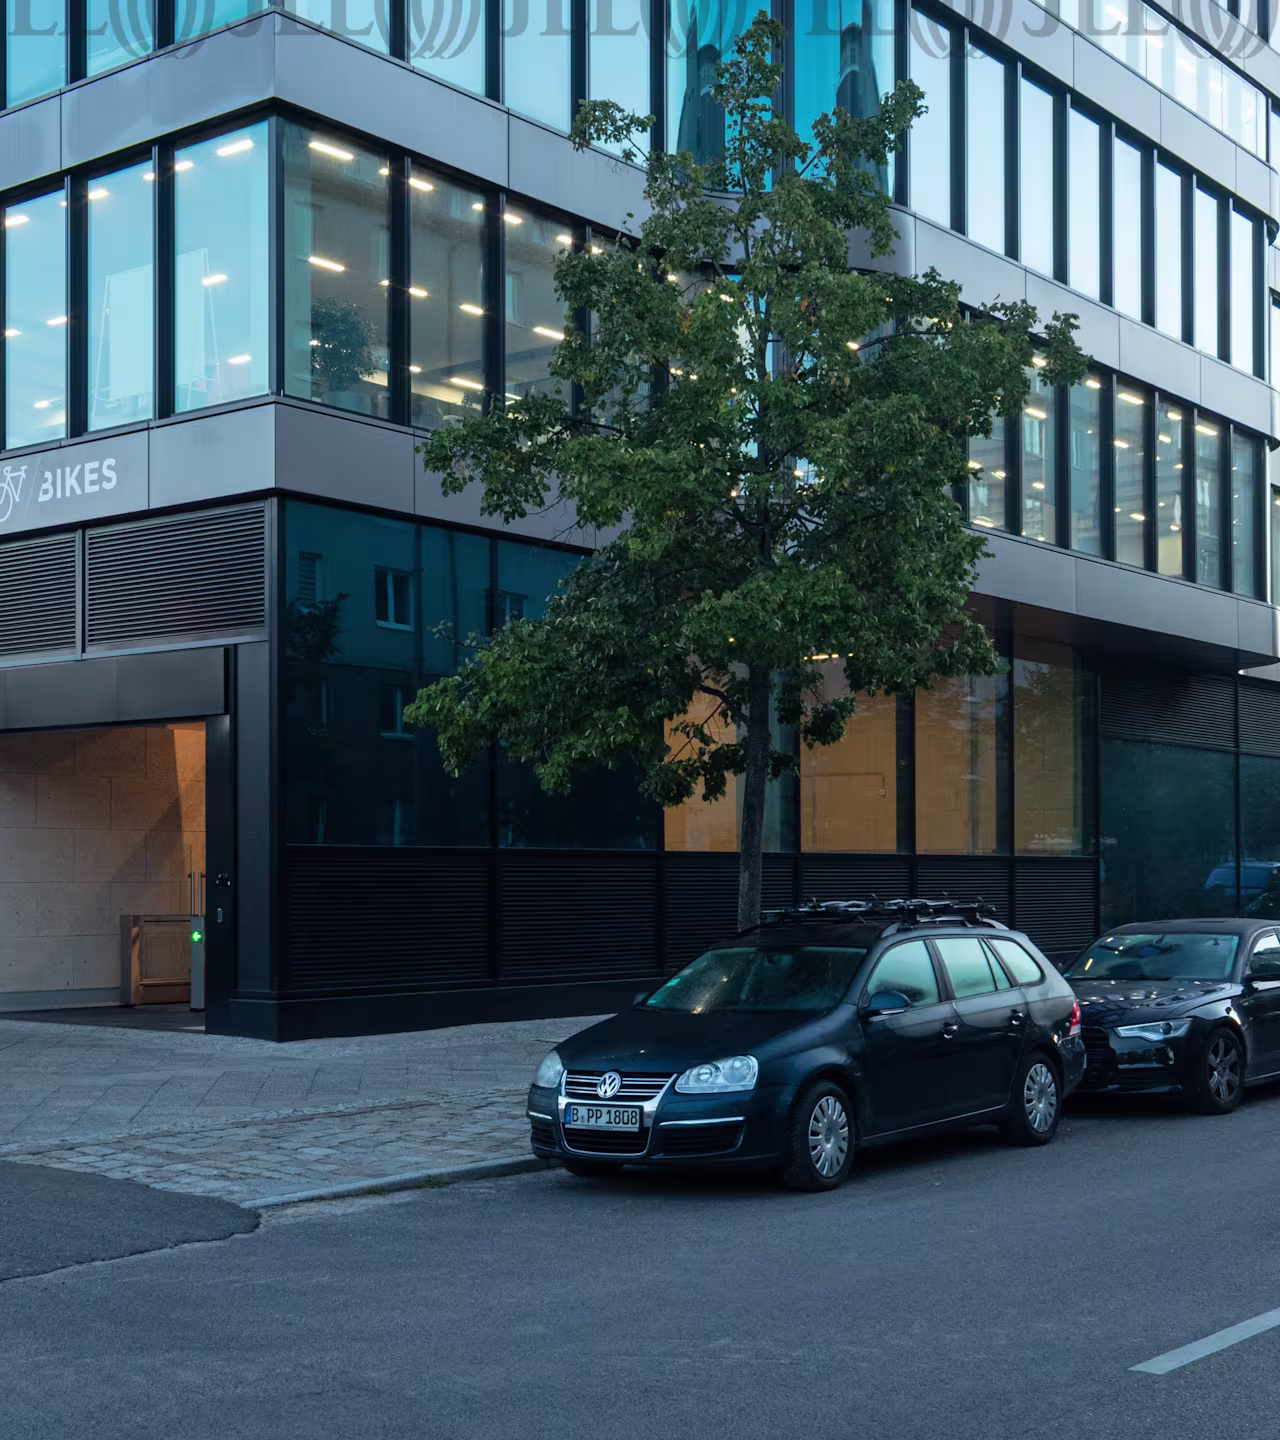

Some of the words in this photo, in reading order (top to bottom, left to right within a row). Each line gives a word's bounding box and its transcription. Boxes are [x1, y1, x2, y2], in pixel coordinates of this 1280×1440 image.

[37, 457, 118, 502] BIKES
[572, 1107, 579, 1123] B
[587, 1108, 603, 1124] PP
[605, 1109, 638, 1125] 1808
